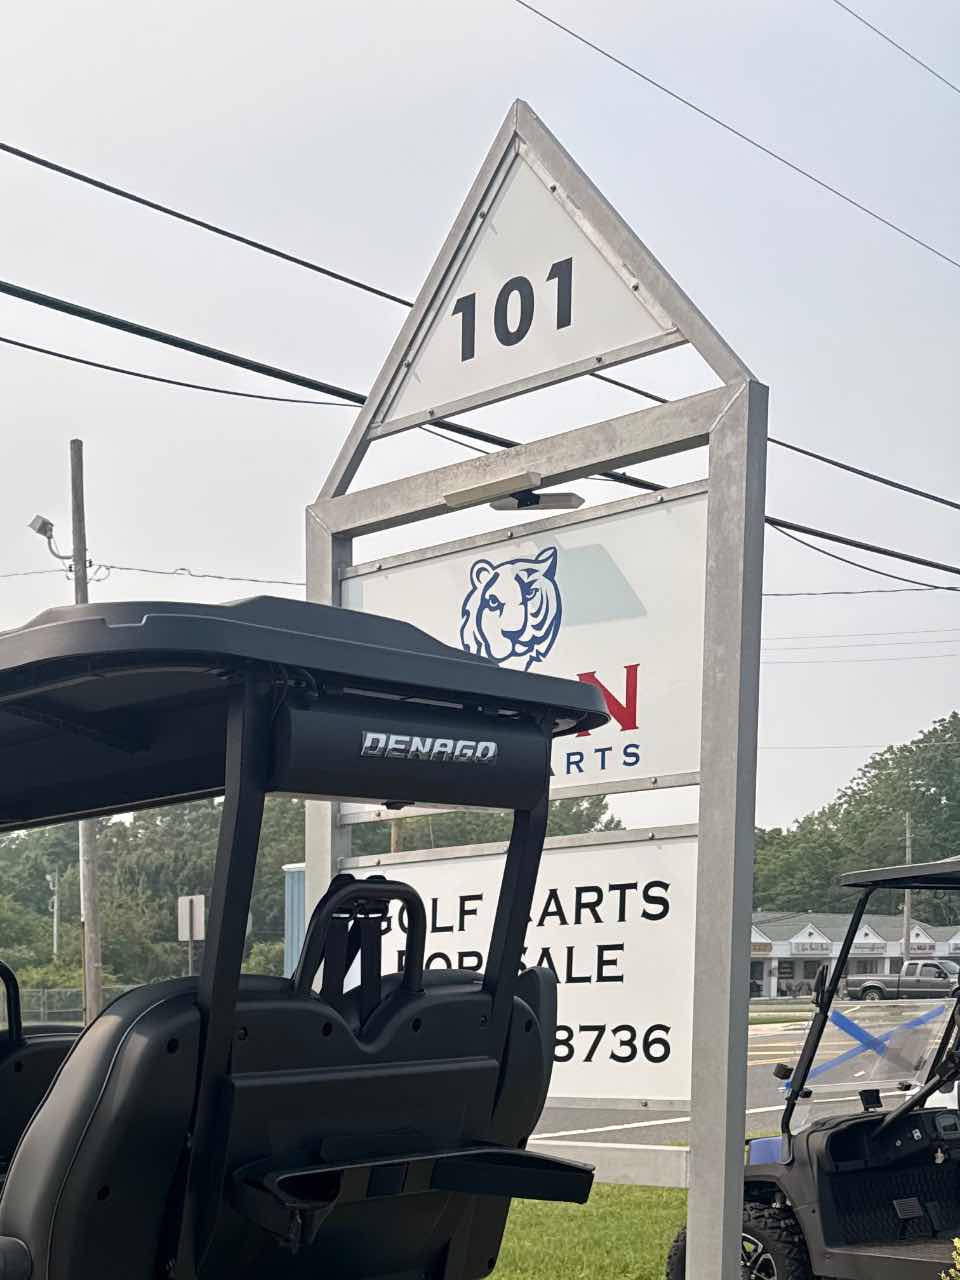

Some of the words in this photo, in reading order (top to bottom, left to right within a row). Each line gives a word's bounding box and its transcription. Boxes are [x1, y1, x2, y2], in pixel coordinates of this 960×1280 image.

[451, 257, 573, 363] 101
[360, 731, 497, 763] DENAGO
[551, 744, 640, 776] RTS
[529, 881, 671, 926] ARTS
[518, 943, 625, 984] ALE
